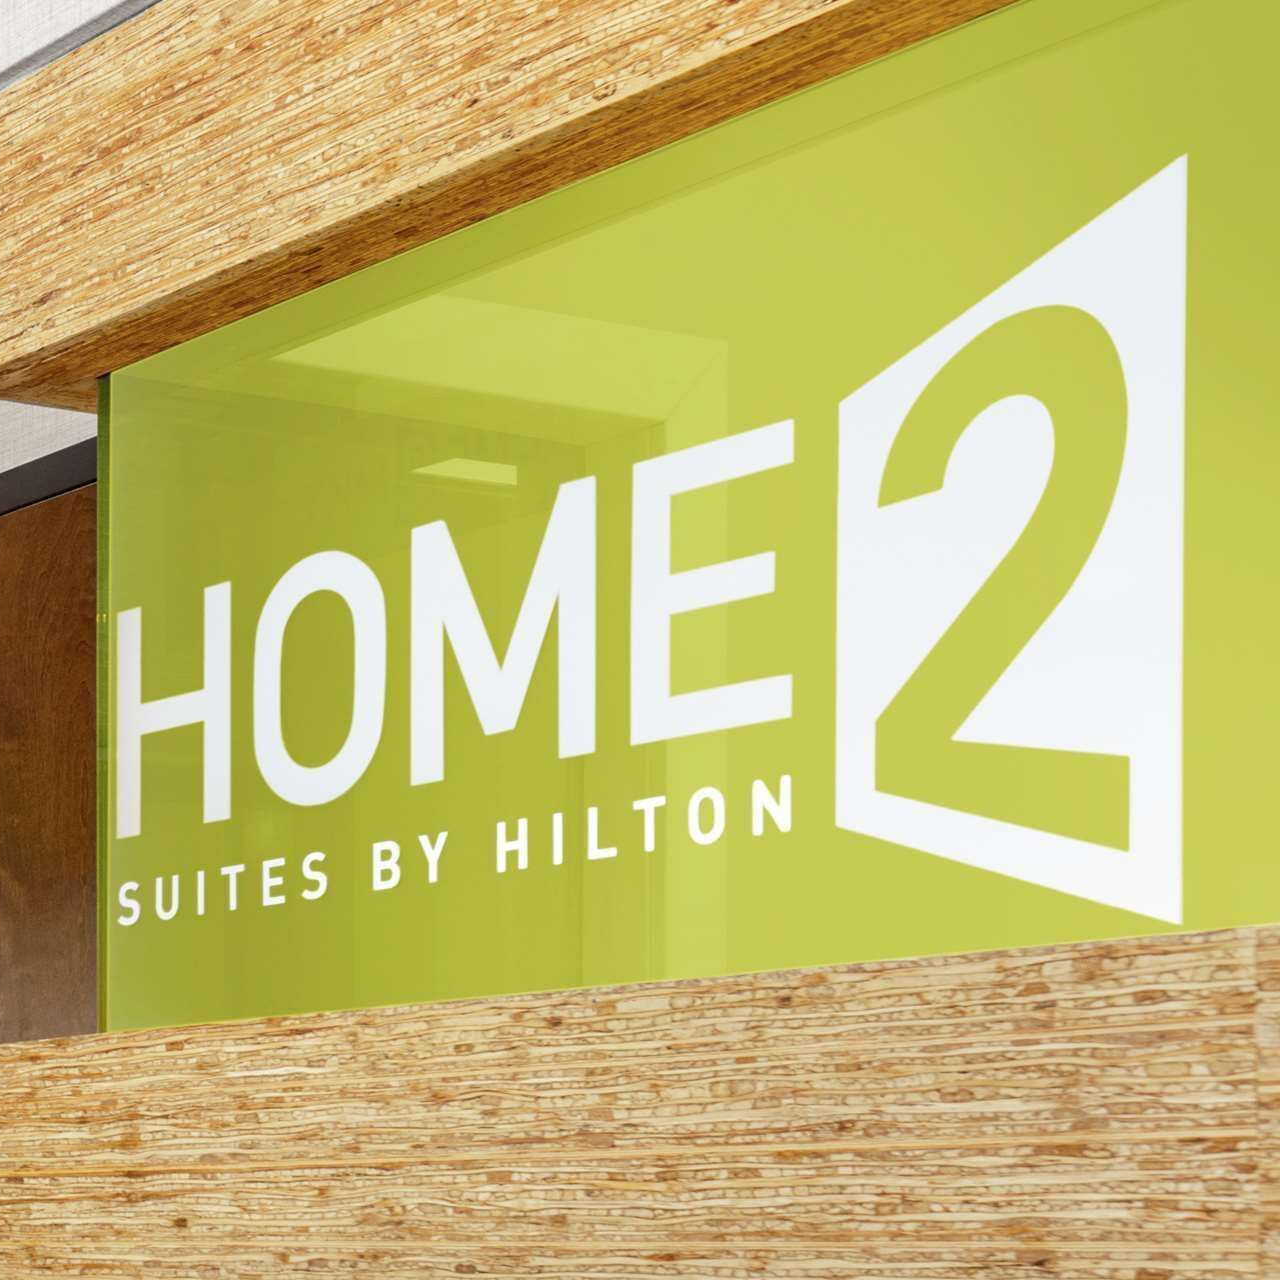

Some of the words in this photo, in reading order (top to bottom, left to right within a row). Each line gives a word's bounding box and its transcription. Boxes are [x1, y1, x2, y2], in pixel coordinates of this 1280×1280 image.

[114, 417, 795, 840] HOME
[872, 303, 1131, 853] 2
[116, 850, 330, 927] SUITES
[370, 830, 450, 892] BY
[495, 773, 794, 876] HILTON
